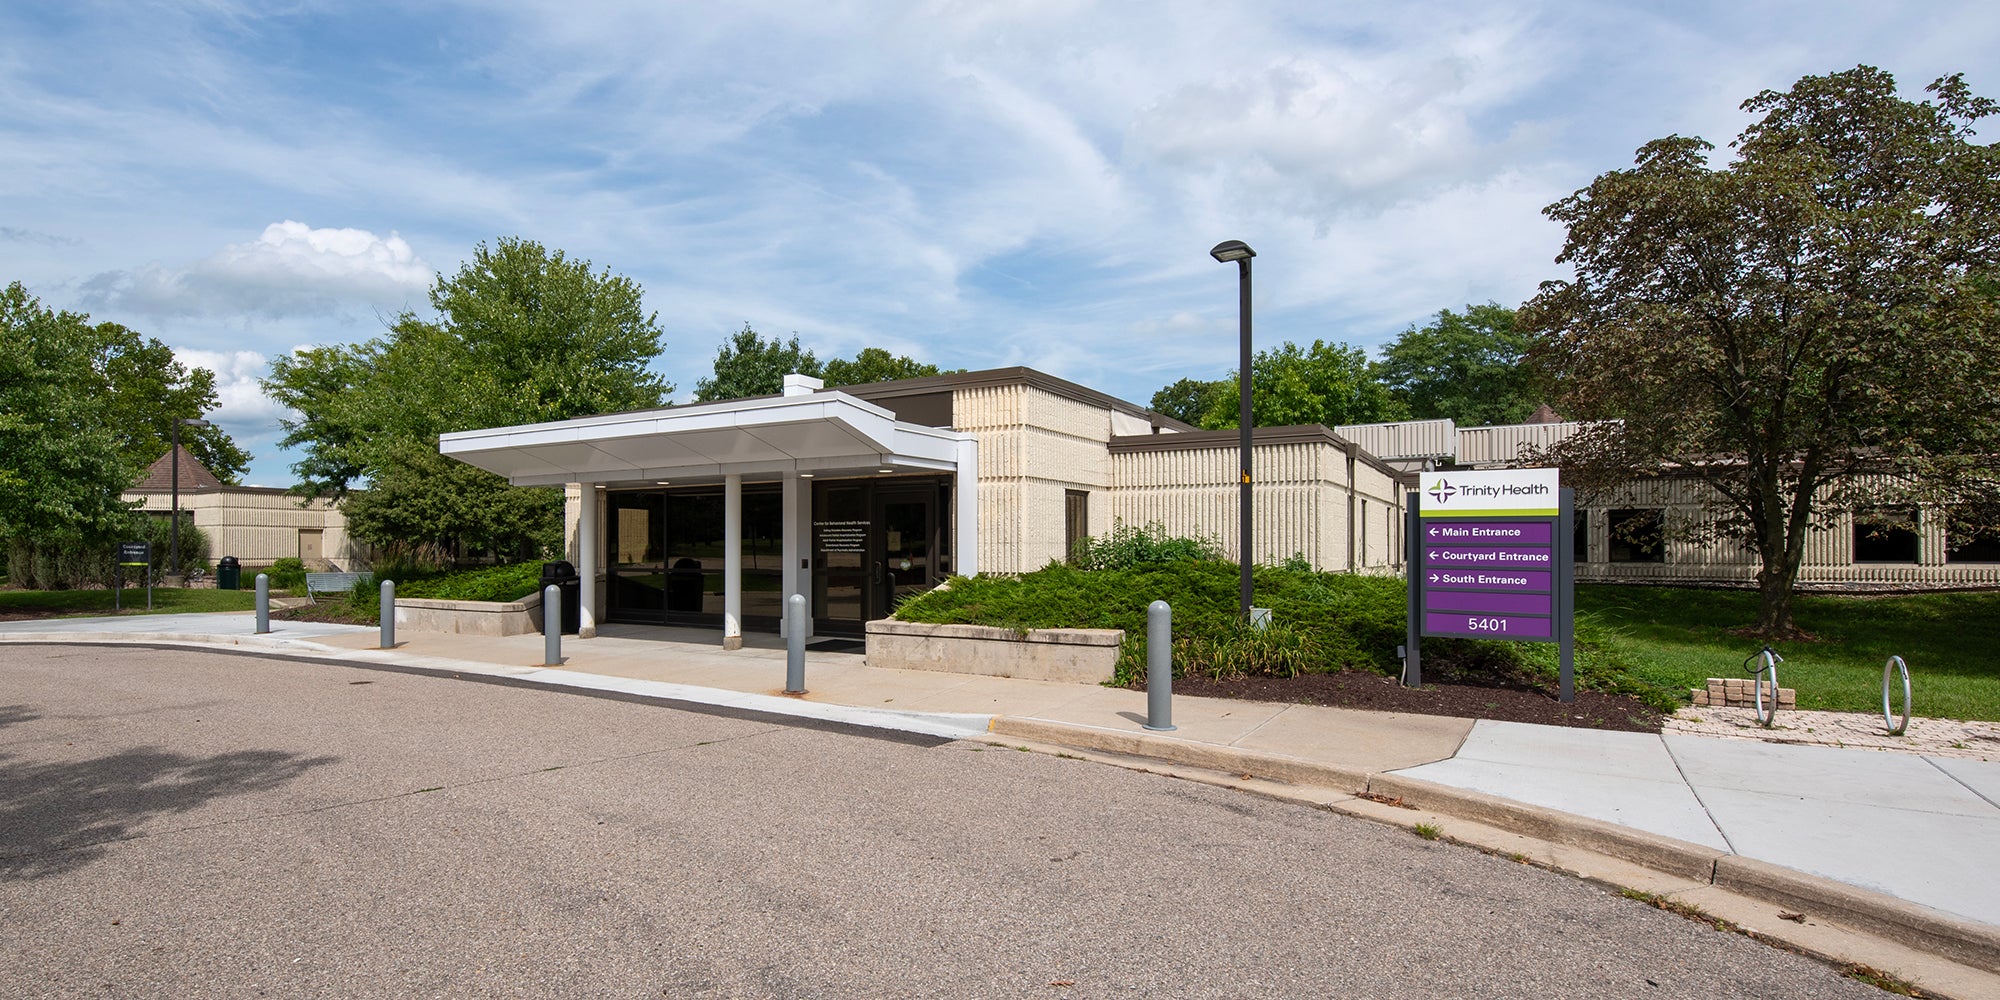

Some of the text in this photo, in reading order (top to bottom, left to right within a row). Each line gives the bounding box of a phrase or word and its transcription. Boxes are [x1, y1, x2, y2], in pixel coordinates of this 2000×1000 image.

[1459, 484, 1549, 498] Trinity Health
[1442, 527, 1521, 537] Main Entrance
[1442, 551, 1549, 562] Courtyard Entrance
[1442, 574, 1528, 585] South Entrance
[1468, 618, 1507, 632] 5401
